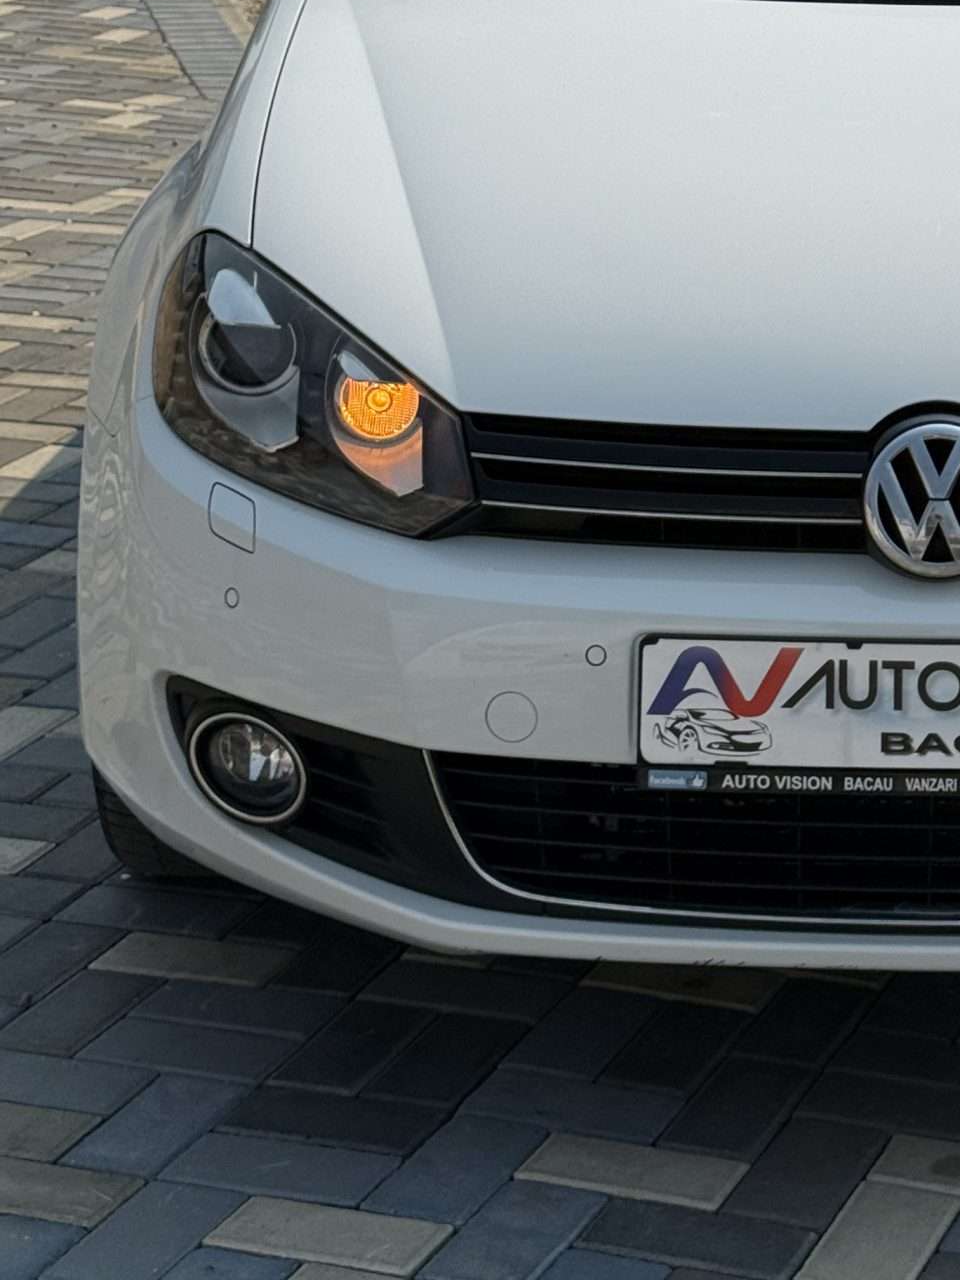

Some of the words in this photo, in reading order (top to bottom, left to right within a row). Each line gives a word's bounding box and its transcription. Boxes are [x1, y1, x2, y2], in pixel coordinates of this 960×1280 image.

[721, 774, 770, 790] AUTO
[774, 776, 833, 791] VISION
[843, 777, 893, 792] BACAU
[905, 777, 958, 792] VANZARI
